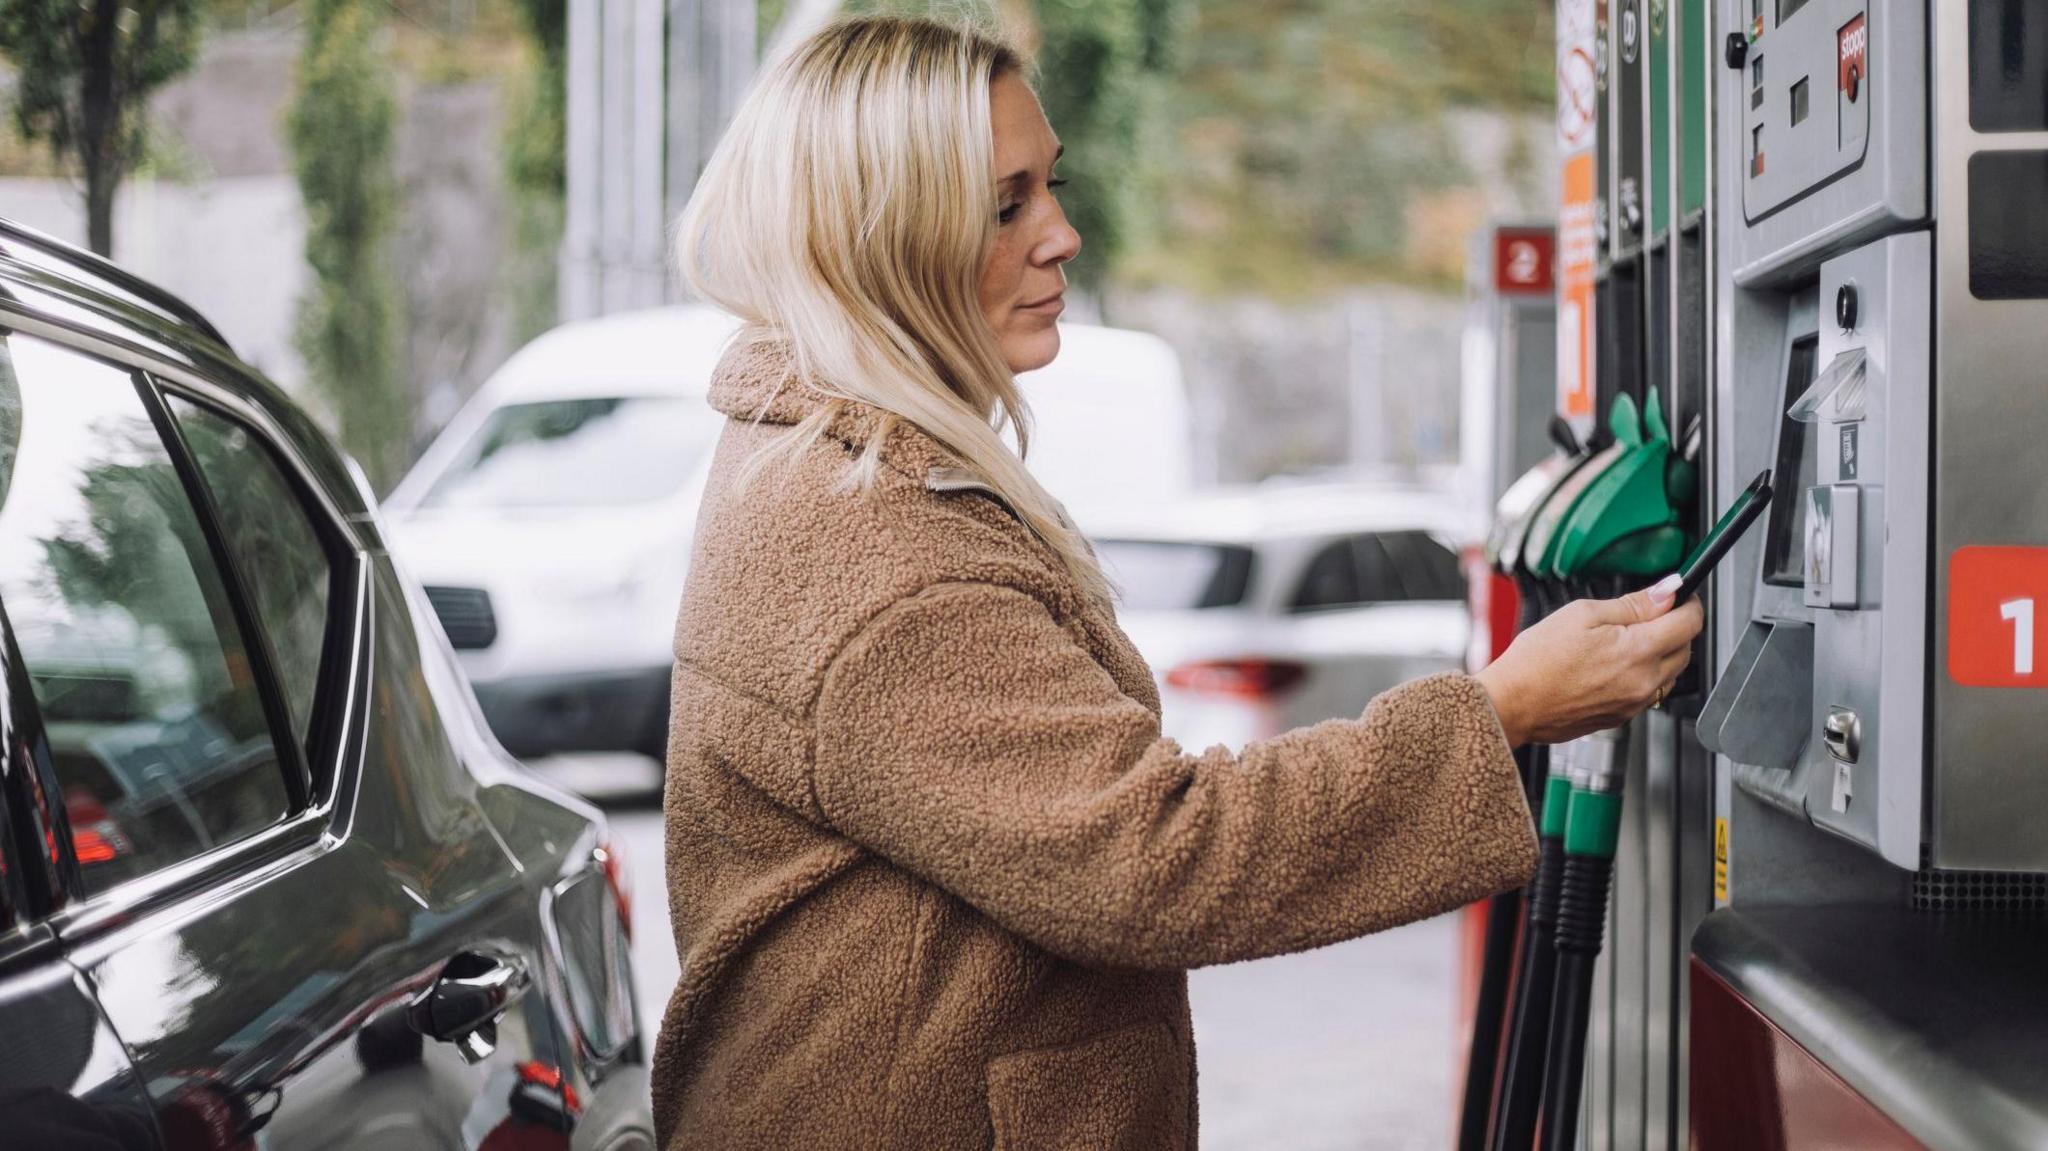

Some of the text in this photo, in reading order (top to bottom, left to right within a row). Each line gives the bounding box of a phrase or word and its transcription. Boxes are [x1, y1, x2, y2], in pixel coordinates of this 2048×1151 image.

[1842, 26, 1865, 60] stopp
[1507, 240, 1540, 284] 2
[2000, 599, 2034, 674] 1
